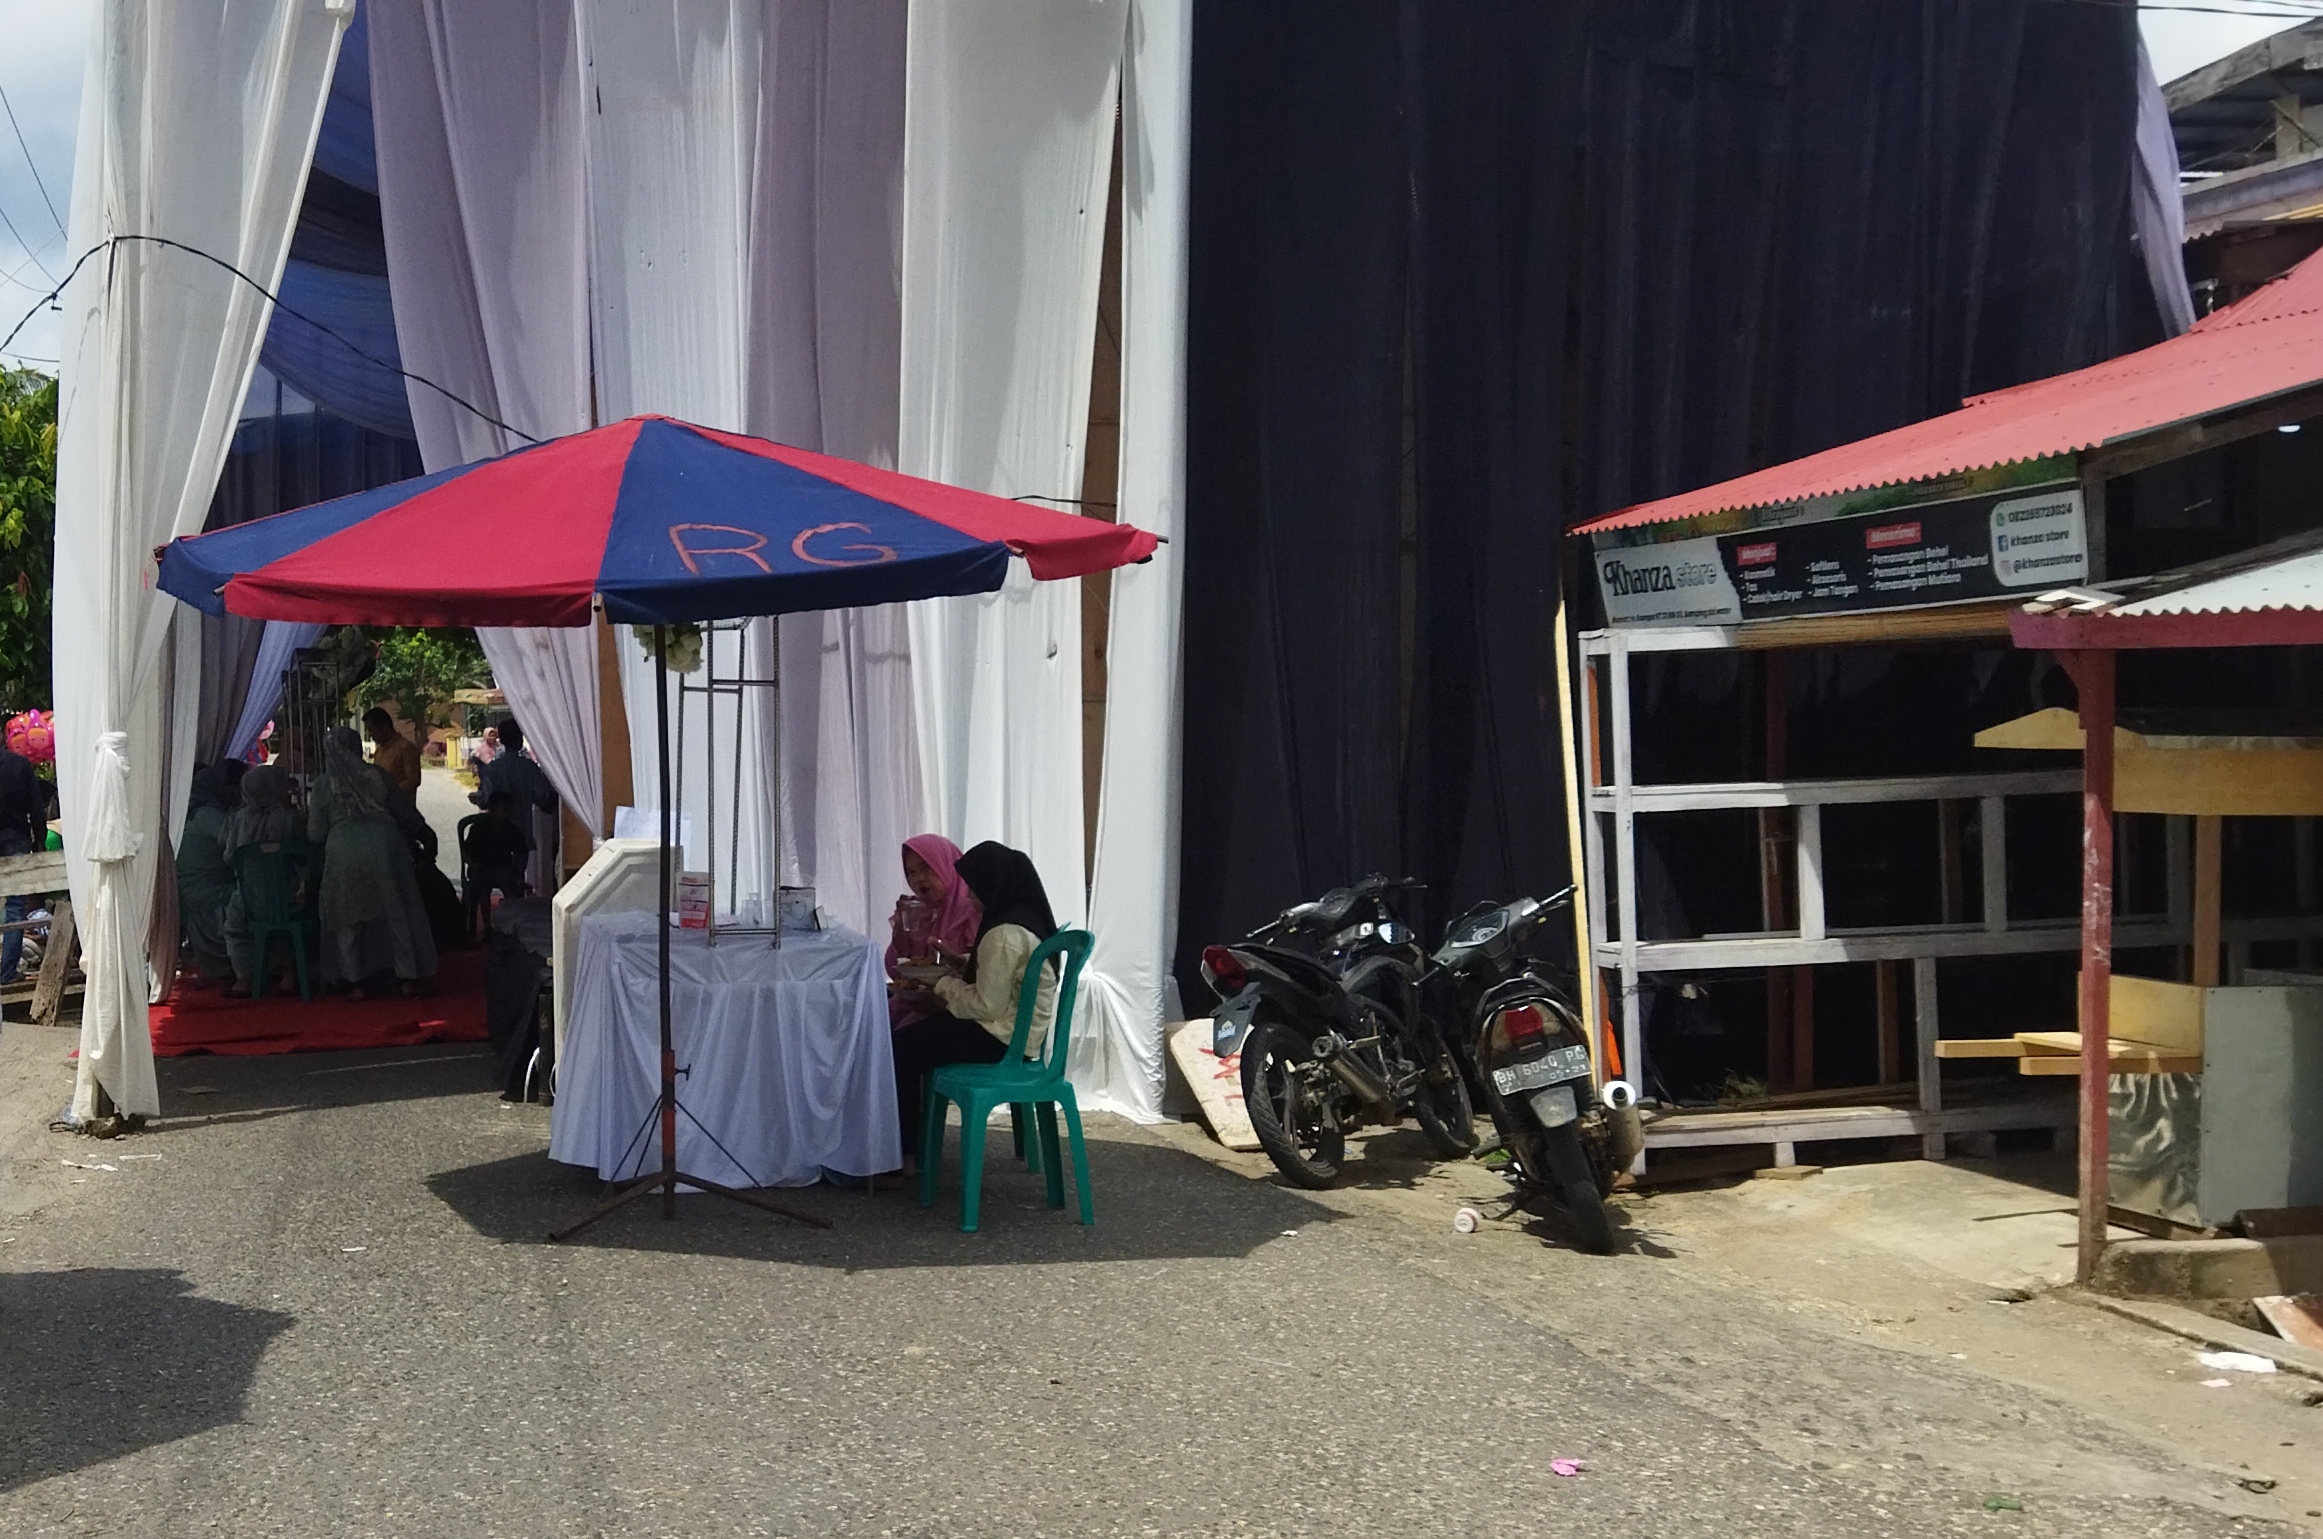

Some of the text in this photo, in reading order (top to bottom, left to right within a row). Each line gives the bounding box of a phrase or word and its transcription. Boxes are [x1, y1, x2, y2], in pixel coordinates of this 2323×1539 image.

[1603, 560, 1717, 597] Khanza store
[1499, 1069, 1517, 1084] BH
